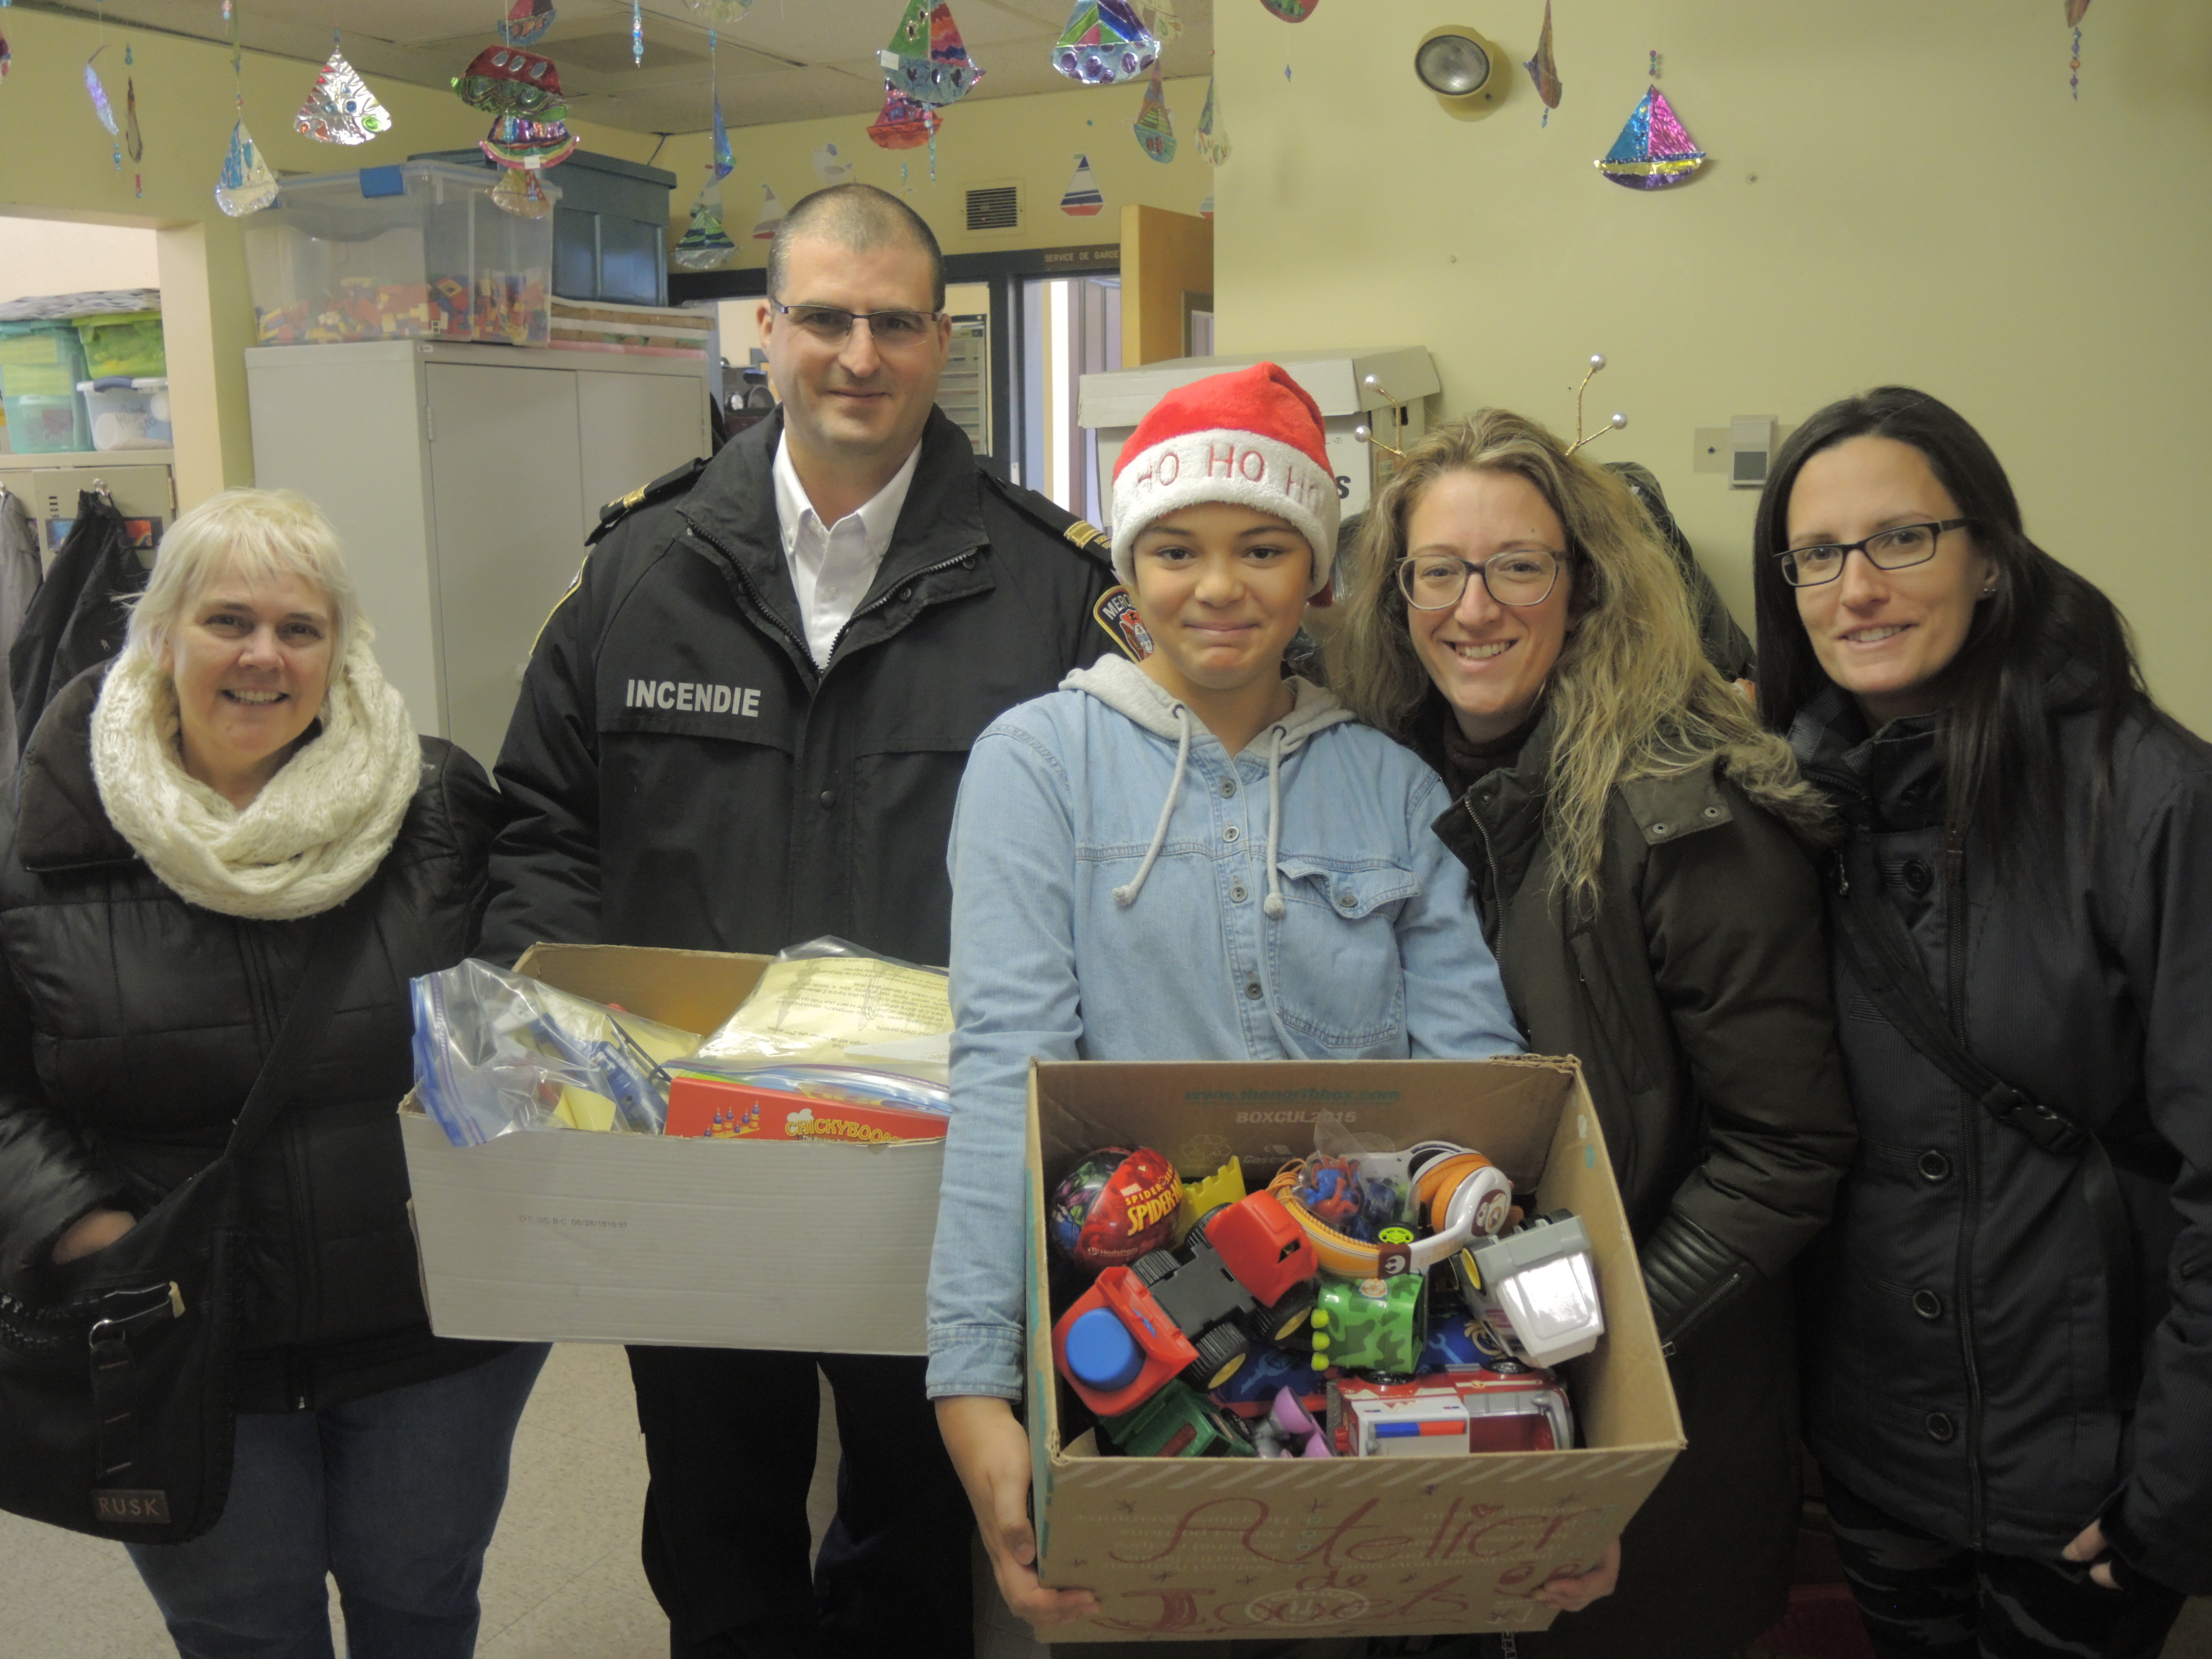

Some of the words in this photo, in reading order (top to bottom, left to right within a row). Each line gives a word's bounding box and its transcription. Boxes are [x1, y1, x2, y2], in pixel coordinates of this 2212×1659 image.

[1045, 253, 1074, 262] SERVICE
[1079, 252, 1089, 260] DE
[1094, 250, 1119, 259] GARDE
[1138, 451, 1180, 491] HO
[1207, 445, 1265, 483] HO
[1103, 594, 1133, 620] MERC
[626, 679, 761, 717] INCENDIE
[1125, 1183, 1164, 1205] SPIDER
[1100, 1247, 1138, 1255] Hedstrom
[98, 1497, 159, 1516] RUSK
[1108, 1497, 1604, 1566] Atelier
[1296, 1569, 1368, 1591] de
